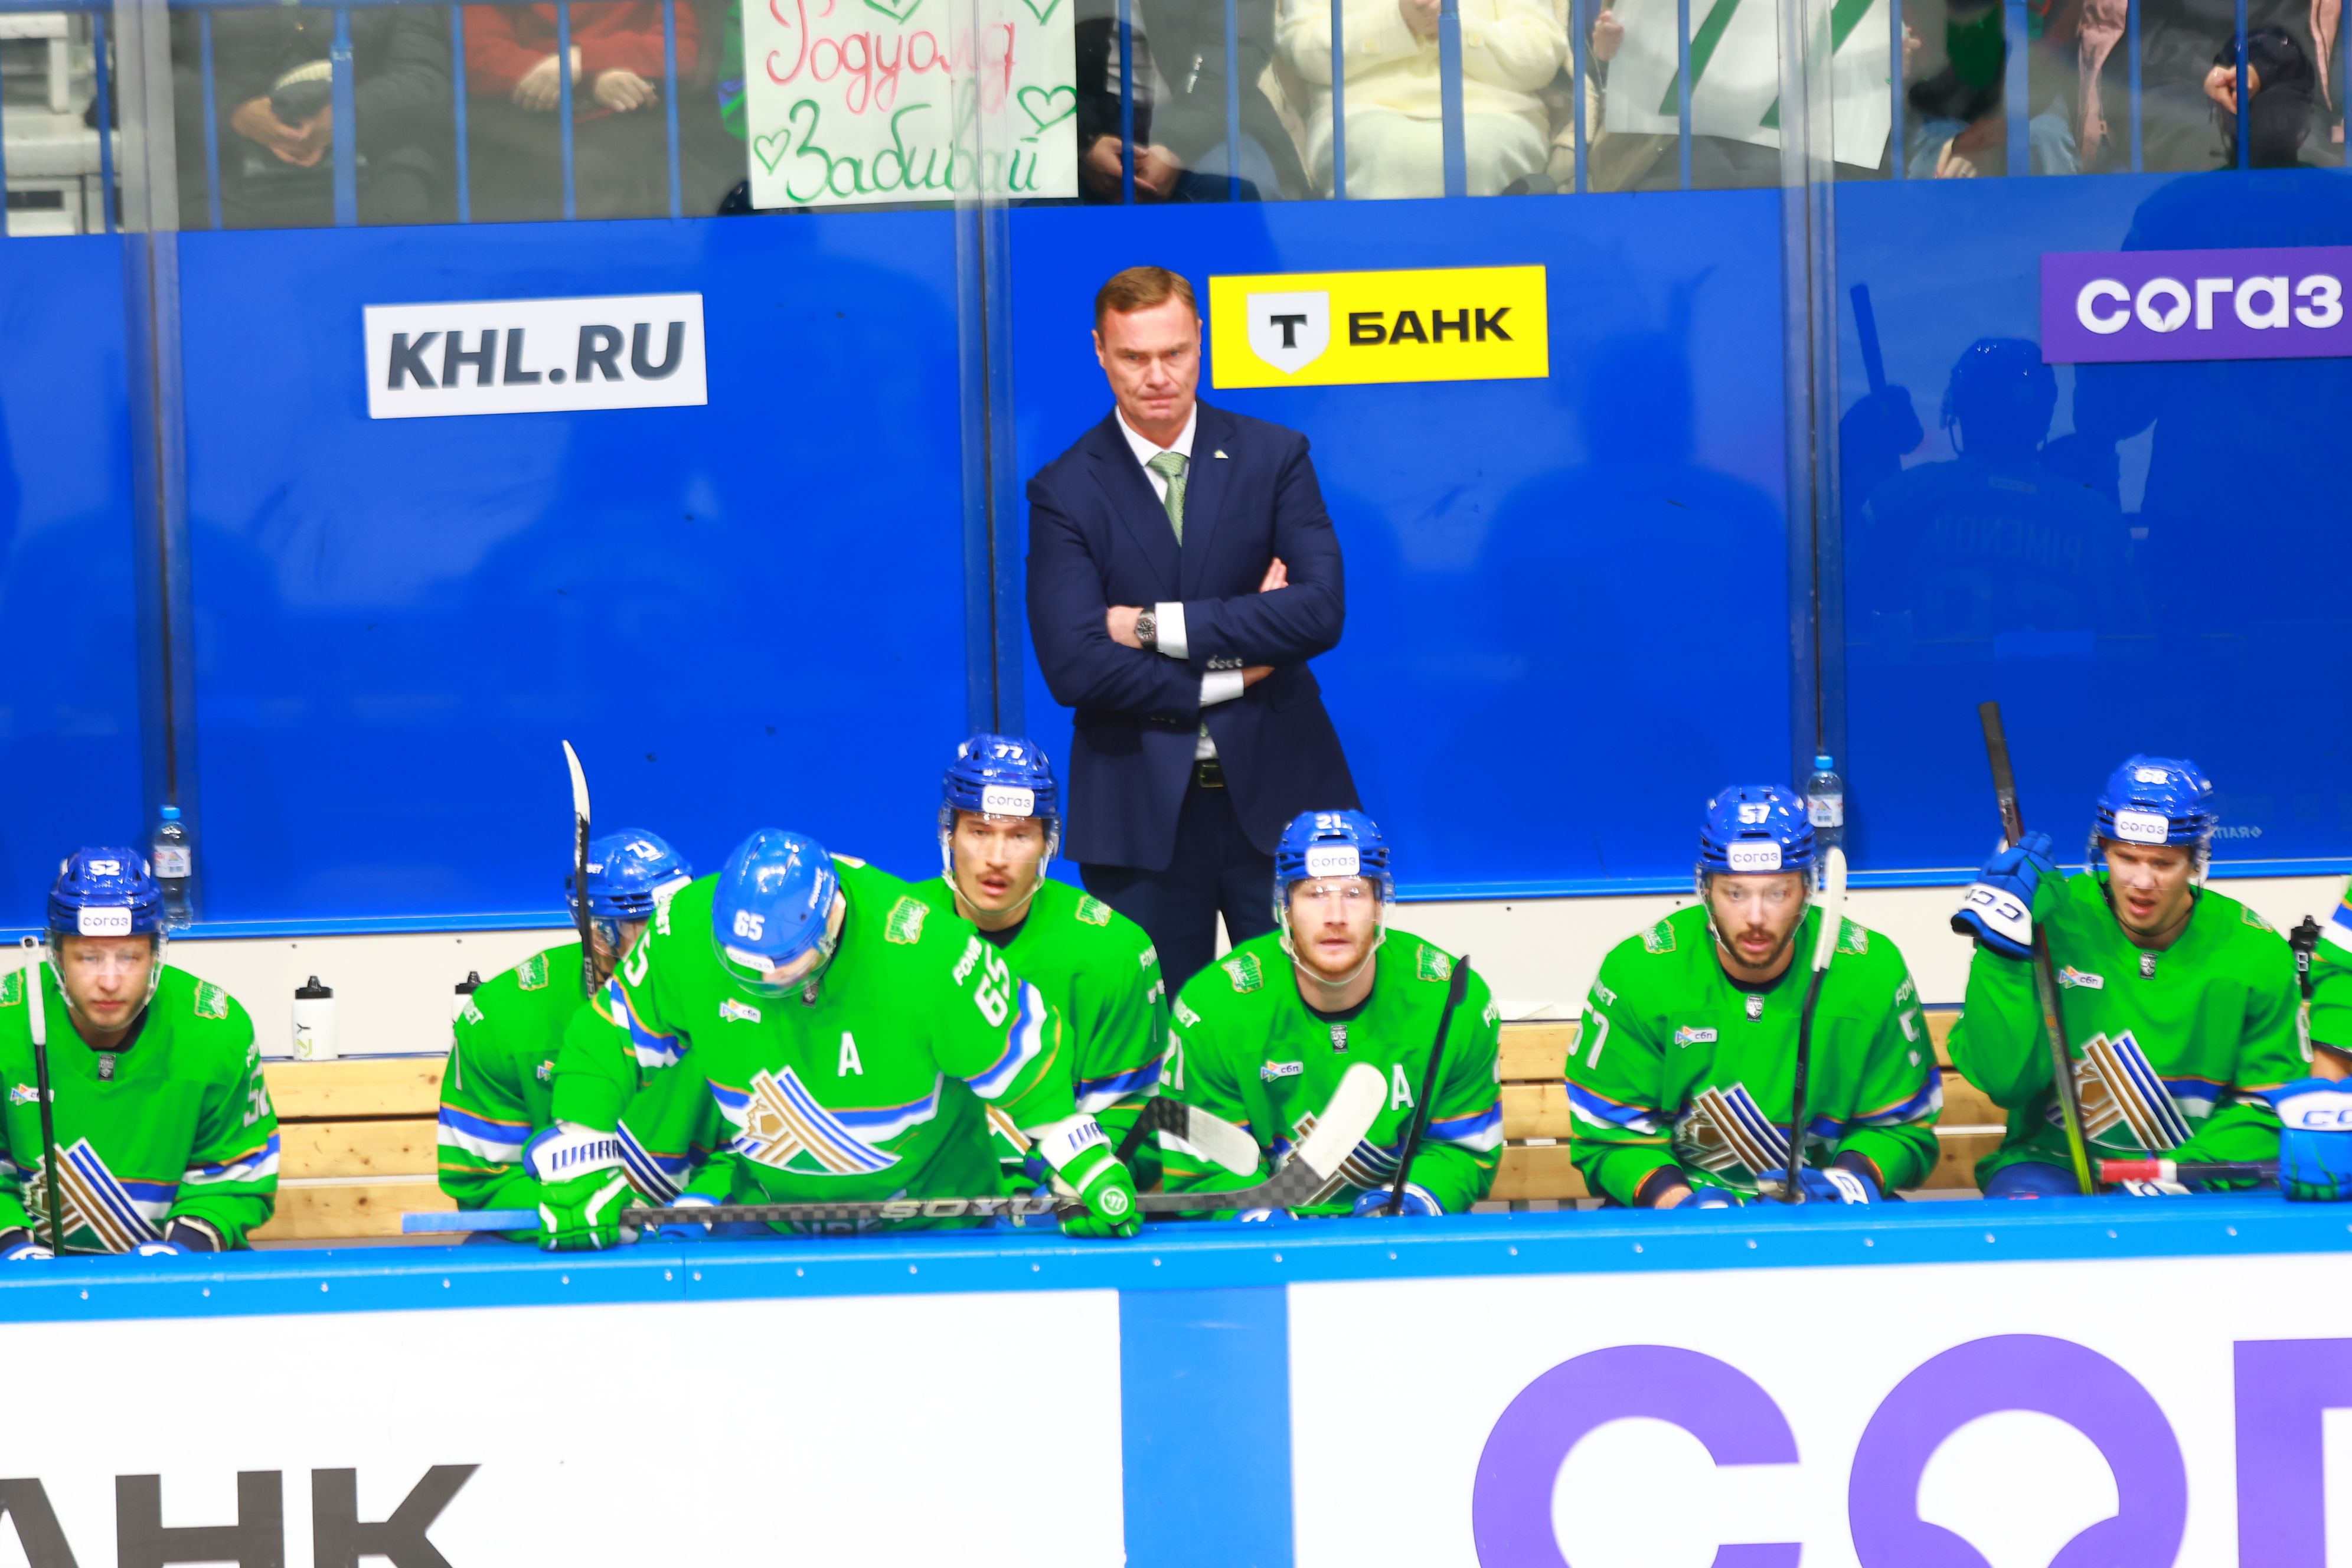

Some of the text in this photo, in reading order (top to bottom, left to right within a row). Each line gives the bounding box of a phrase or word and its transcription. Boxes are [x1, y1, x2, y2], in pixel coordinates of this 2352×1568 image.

[1348, 307, 1514, 347] БАНК
[387, 322, 687, 391] KHL.RU
[994, 744, 1024, 759] 77
[1315, 815, 1341, 829] 21
[1739, 803, 1771, 824] 57
[89, 860, 121, 876] 52
[733, 909, 766, 942] 65
[838, 1031, 864, 1077] A
[1280, 1064, 1300, 1075] сбп
[1391, 1064, 1415, 1110] A
[879, 1197, 1061, 1219] SOYU
